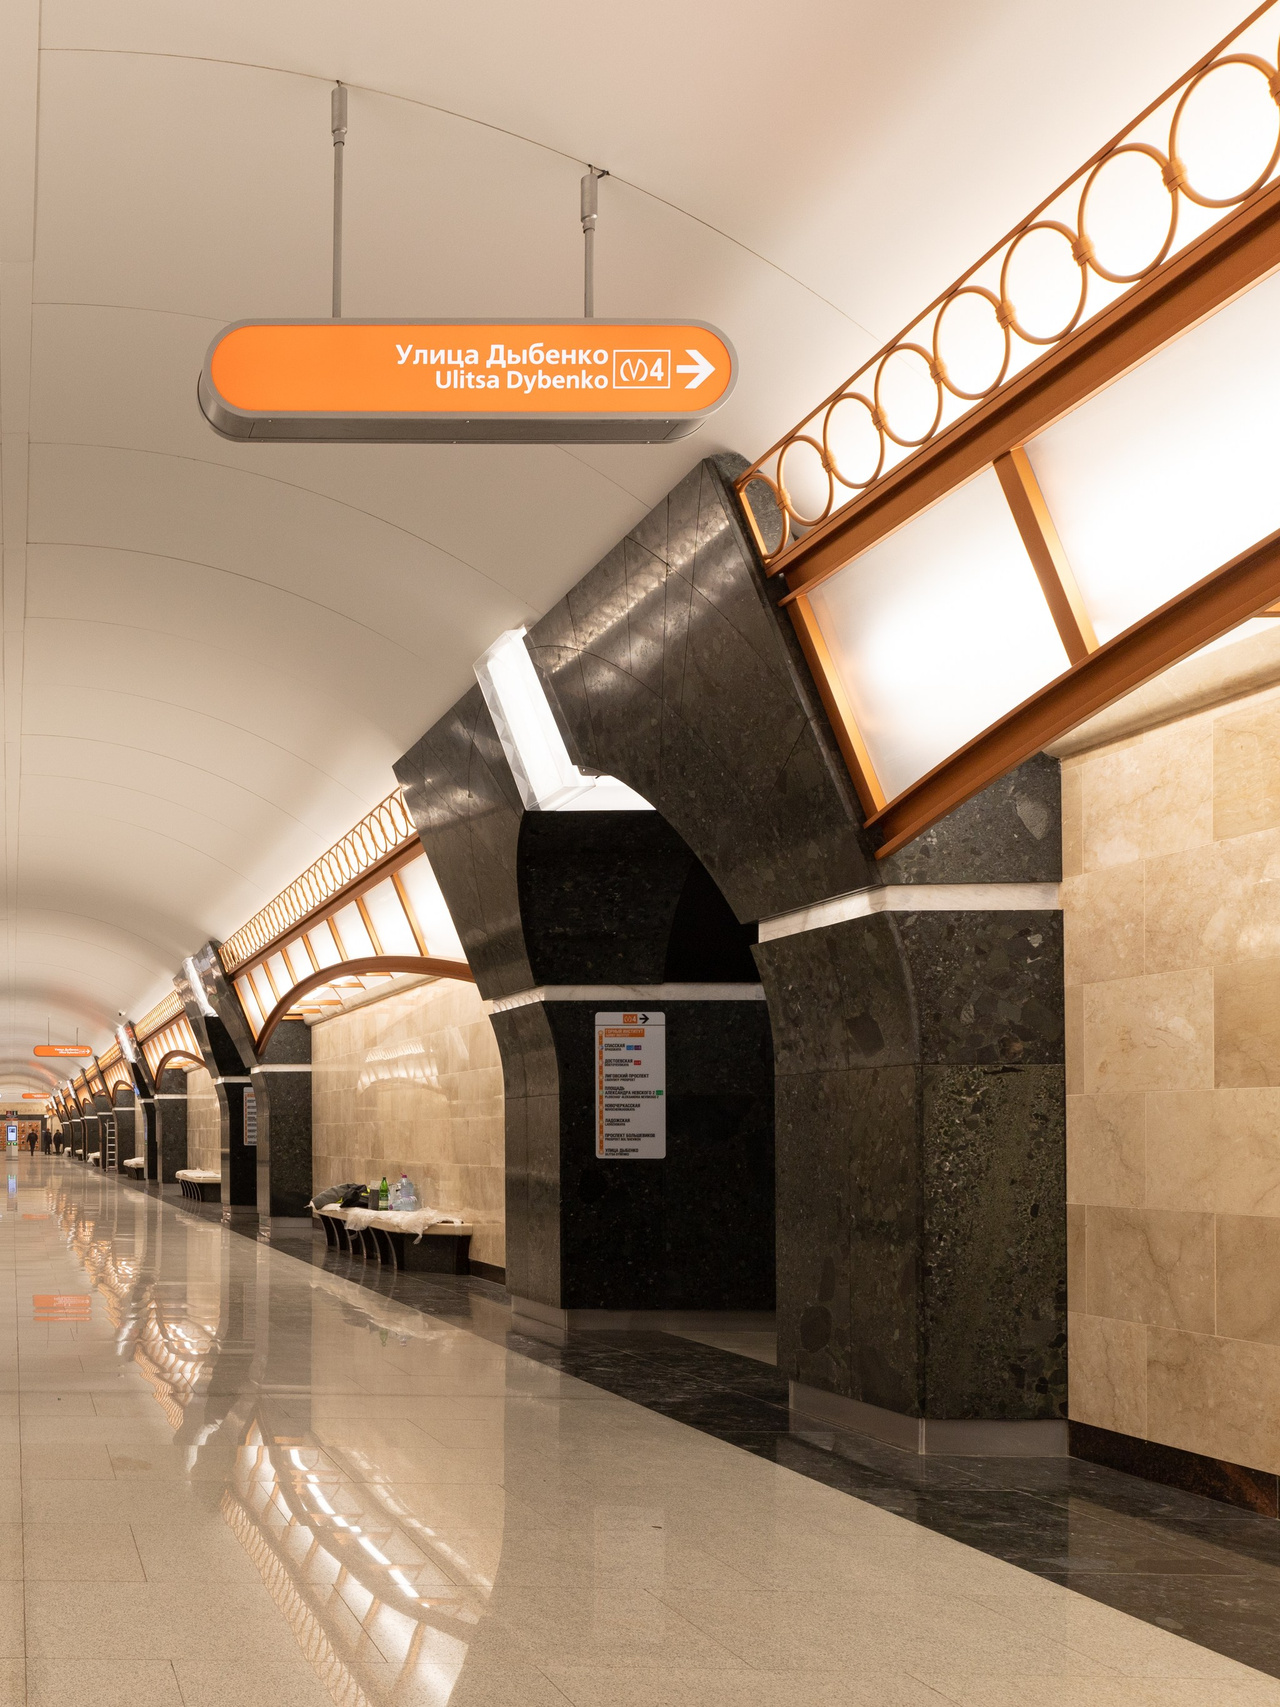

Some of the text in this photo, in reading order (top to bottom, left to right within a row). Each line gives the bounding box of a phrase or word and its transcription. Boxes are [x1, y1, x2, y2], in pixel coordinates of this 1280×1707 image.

[395, 342, 609, 369] Улица Дыбенко
[435, 370, 609, 394] Ulitsa Dybenko
